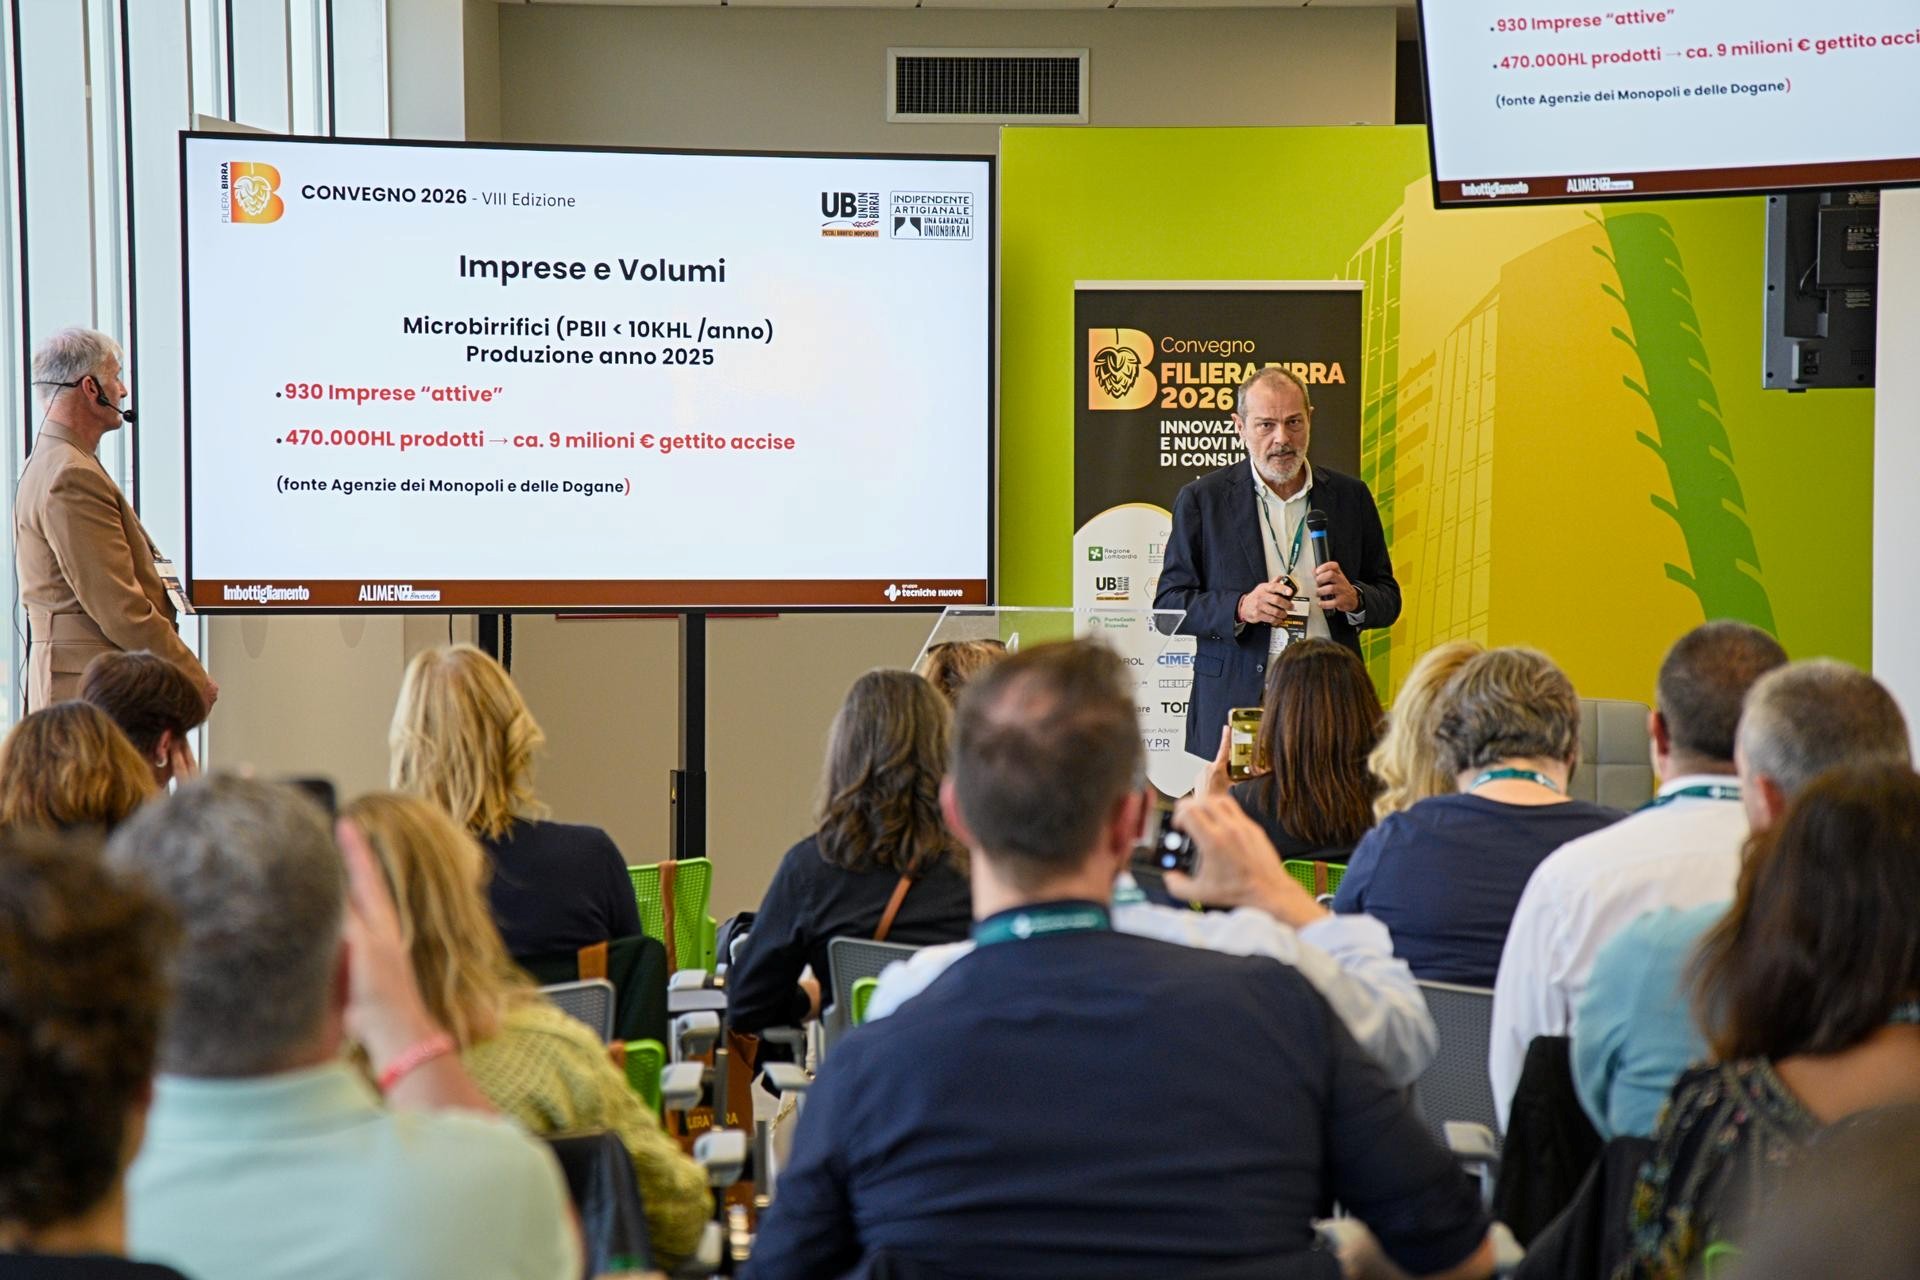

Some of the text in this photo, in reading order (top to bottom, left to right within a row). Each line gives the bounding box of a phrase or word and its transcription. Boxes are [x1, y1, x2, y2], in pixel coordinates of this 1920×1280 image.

[1497, 18, 1527, 32] 930
[1531, 15, 1602, 33] Imprese
[1500, 52, 1587, 69] 470.000HL
[1592, 46, 1661, 68] prodotti
[1686, 46, 1713, 59] ca.
[1717, 43, 1727, 57] 9
[1731, 38, 1793, 56] milioni
[1798, 38, 1810, 51] €
[1815, 33, 1877, 55] gettito
[1496, 78, 1791, 109] (fonte Agenzie dei Monopoli e delle Dogane)
[221, 162, 229, 223] FILIERA BIRRA
[301, 184, 416, 203] CONVEGNO
[421, 188, 467, 204] 2026
[482, 191, 507, 206] VIII
[512, 192, 576, 208] Edizione
[894, 195, 970, 204] INDIPENDENTE
[821, 192, 857, 218] UB
[858, 192, 868, 218] UNION
[869, 192, 879, 219] BIRRAI
[894, 206, 969, 215] ARTIGIANALE
[924, 225, 970, 237] UNIONBIRRAI
[459, 254, 726, 286] Imprese e Volumi
[403, 316, 774, 344] Microbirrifici (PBII < 10KHL /anno)
[466, 345, 714, 365] Produzione anno 2025
[1161, 336, 1256, 358] Convegno
[1161, 362, 1257, 384] FILIERA
[285, 383, 323, 400] 930
[329, 384, 416, 405] Imprese
[1161, 387, 1233, 410] 2026
[285, 429, 795, 454] 470.000HL prodotti ca. 9 milioni € gettito accise
[1160, 436, 1170, 450] E
[1174, 436, 1226, 450] NUOVI
[1160, 452, 1176, 466] DI
[277, 475, 631, 496] (fonte Agenzie dei Monopoli e delle Dogane)
[223, 584, 310, 604] Imbottigliamento
[902, 588, 963, 597] tecniche nuove
[1096, 576, 1117, 591] UB
[1155, 739, 1170, 748] PR
